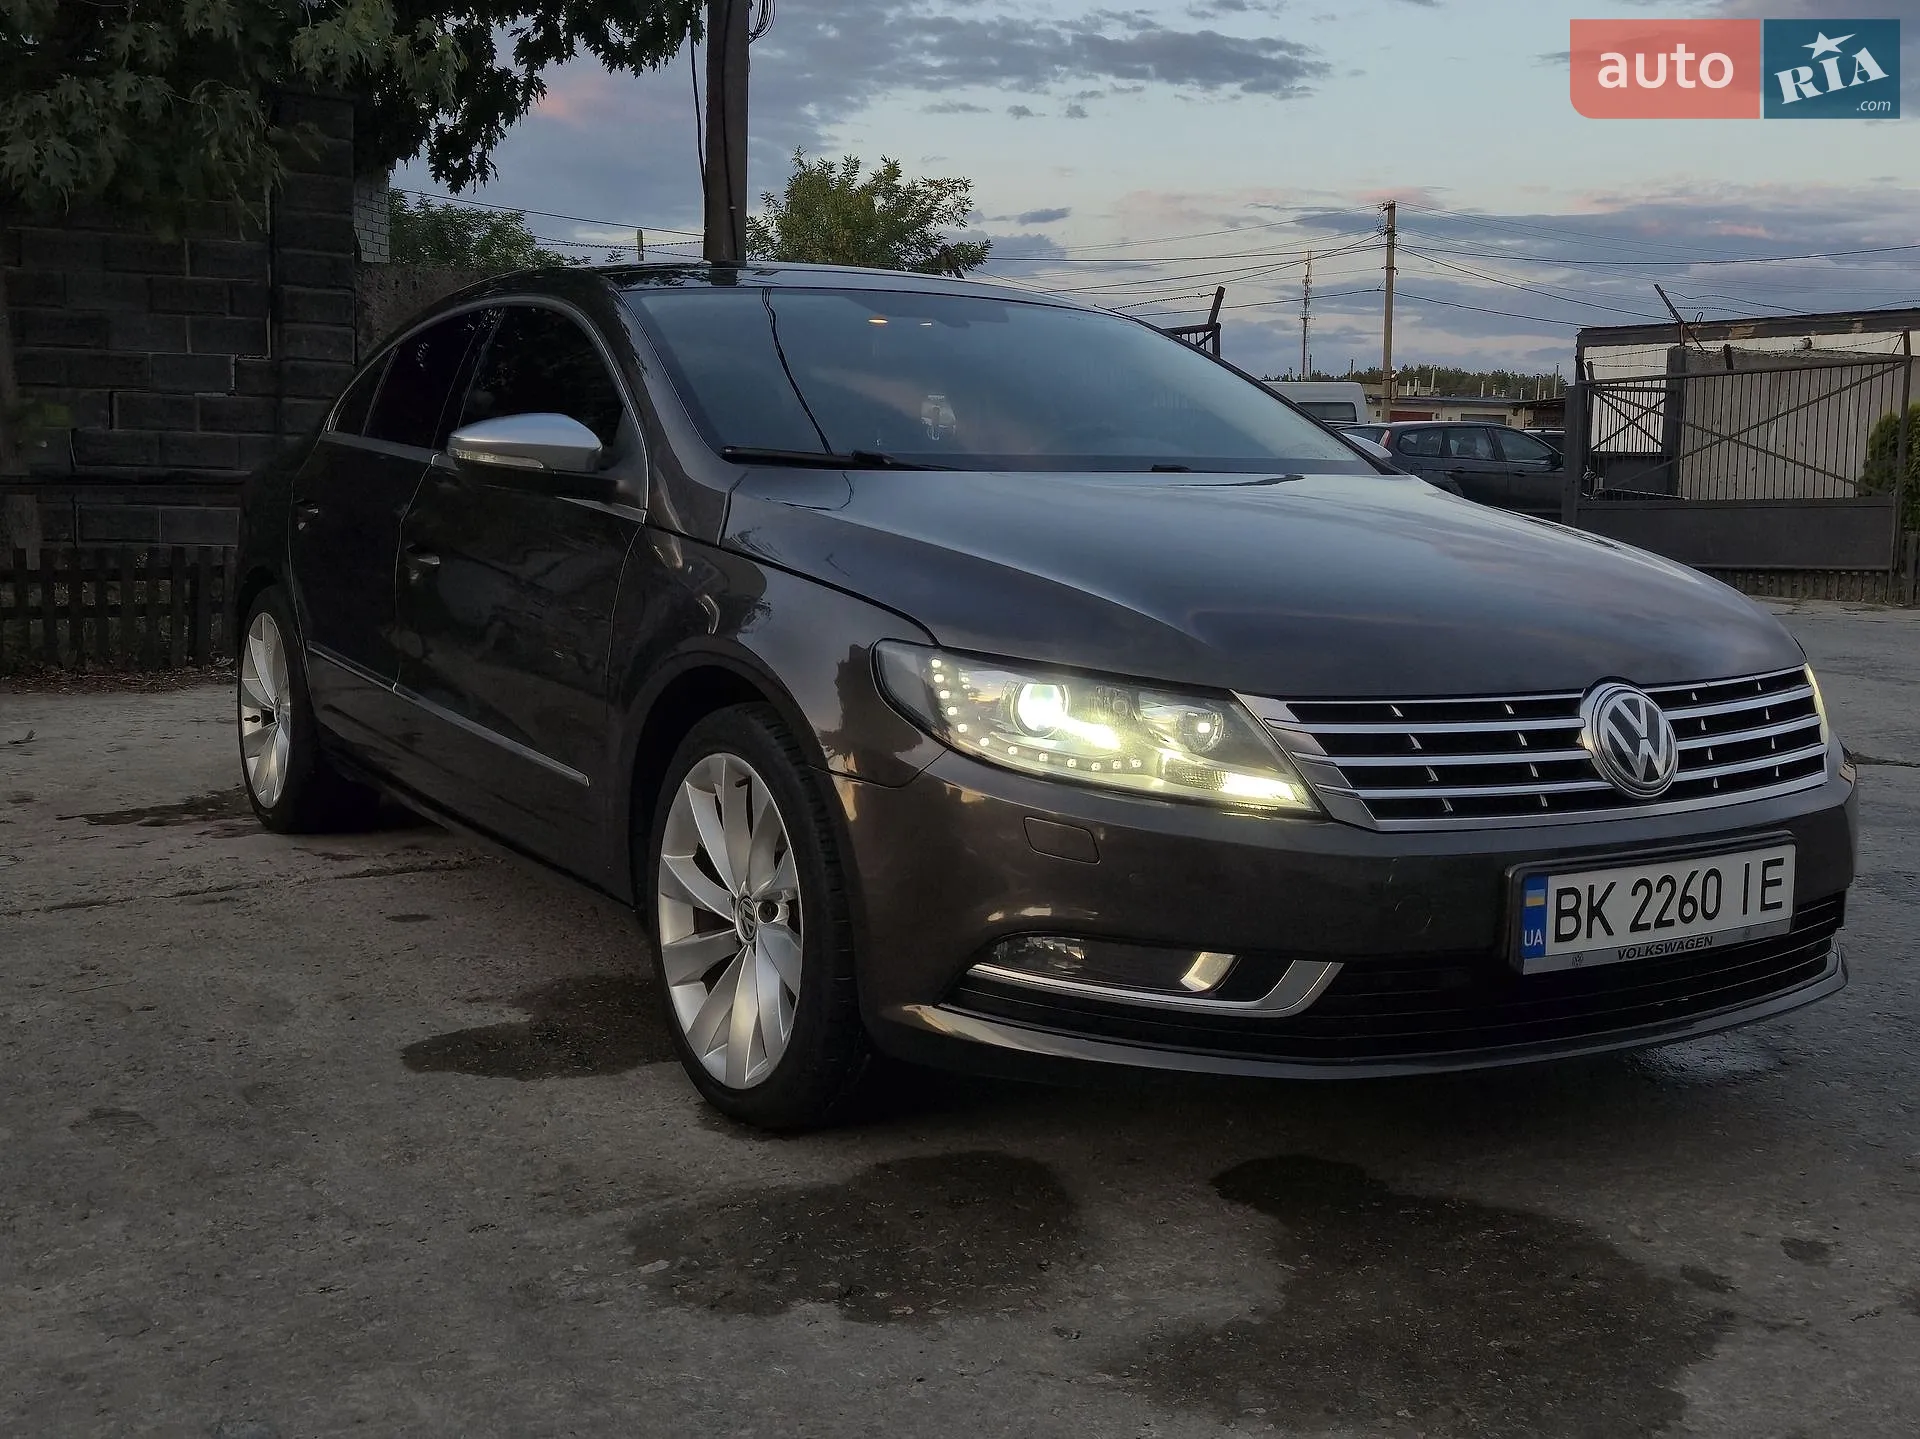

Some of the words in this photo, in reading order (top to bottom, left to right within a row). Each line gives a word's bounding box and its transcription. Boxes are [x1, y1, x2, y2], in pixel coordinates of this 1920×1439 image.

[1554, 881, 1616, 943] BK
[1629, 867, 1722, 933] 2260
[1742, 857, 1784, 915] IE
[1524, 928, 1543, 946] UA
[1617, 935, 1713, 961] VOLKSWAGEN
